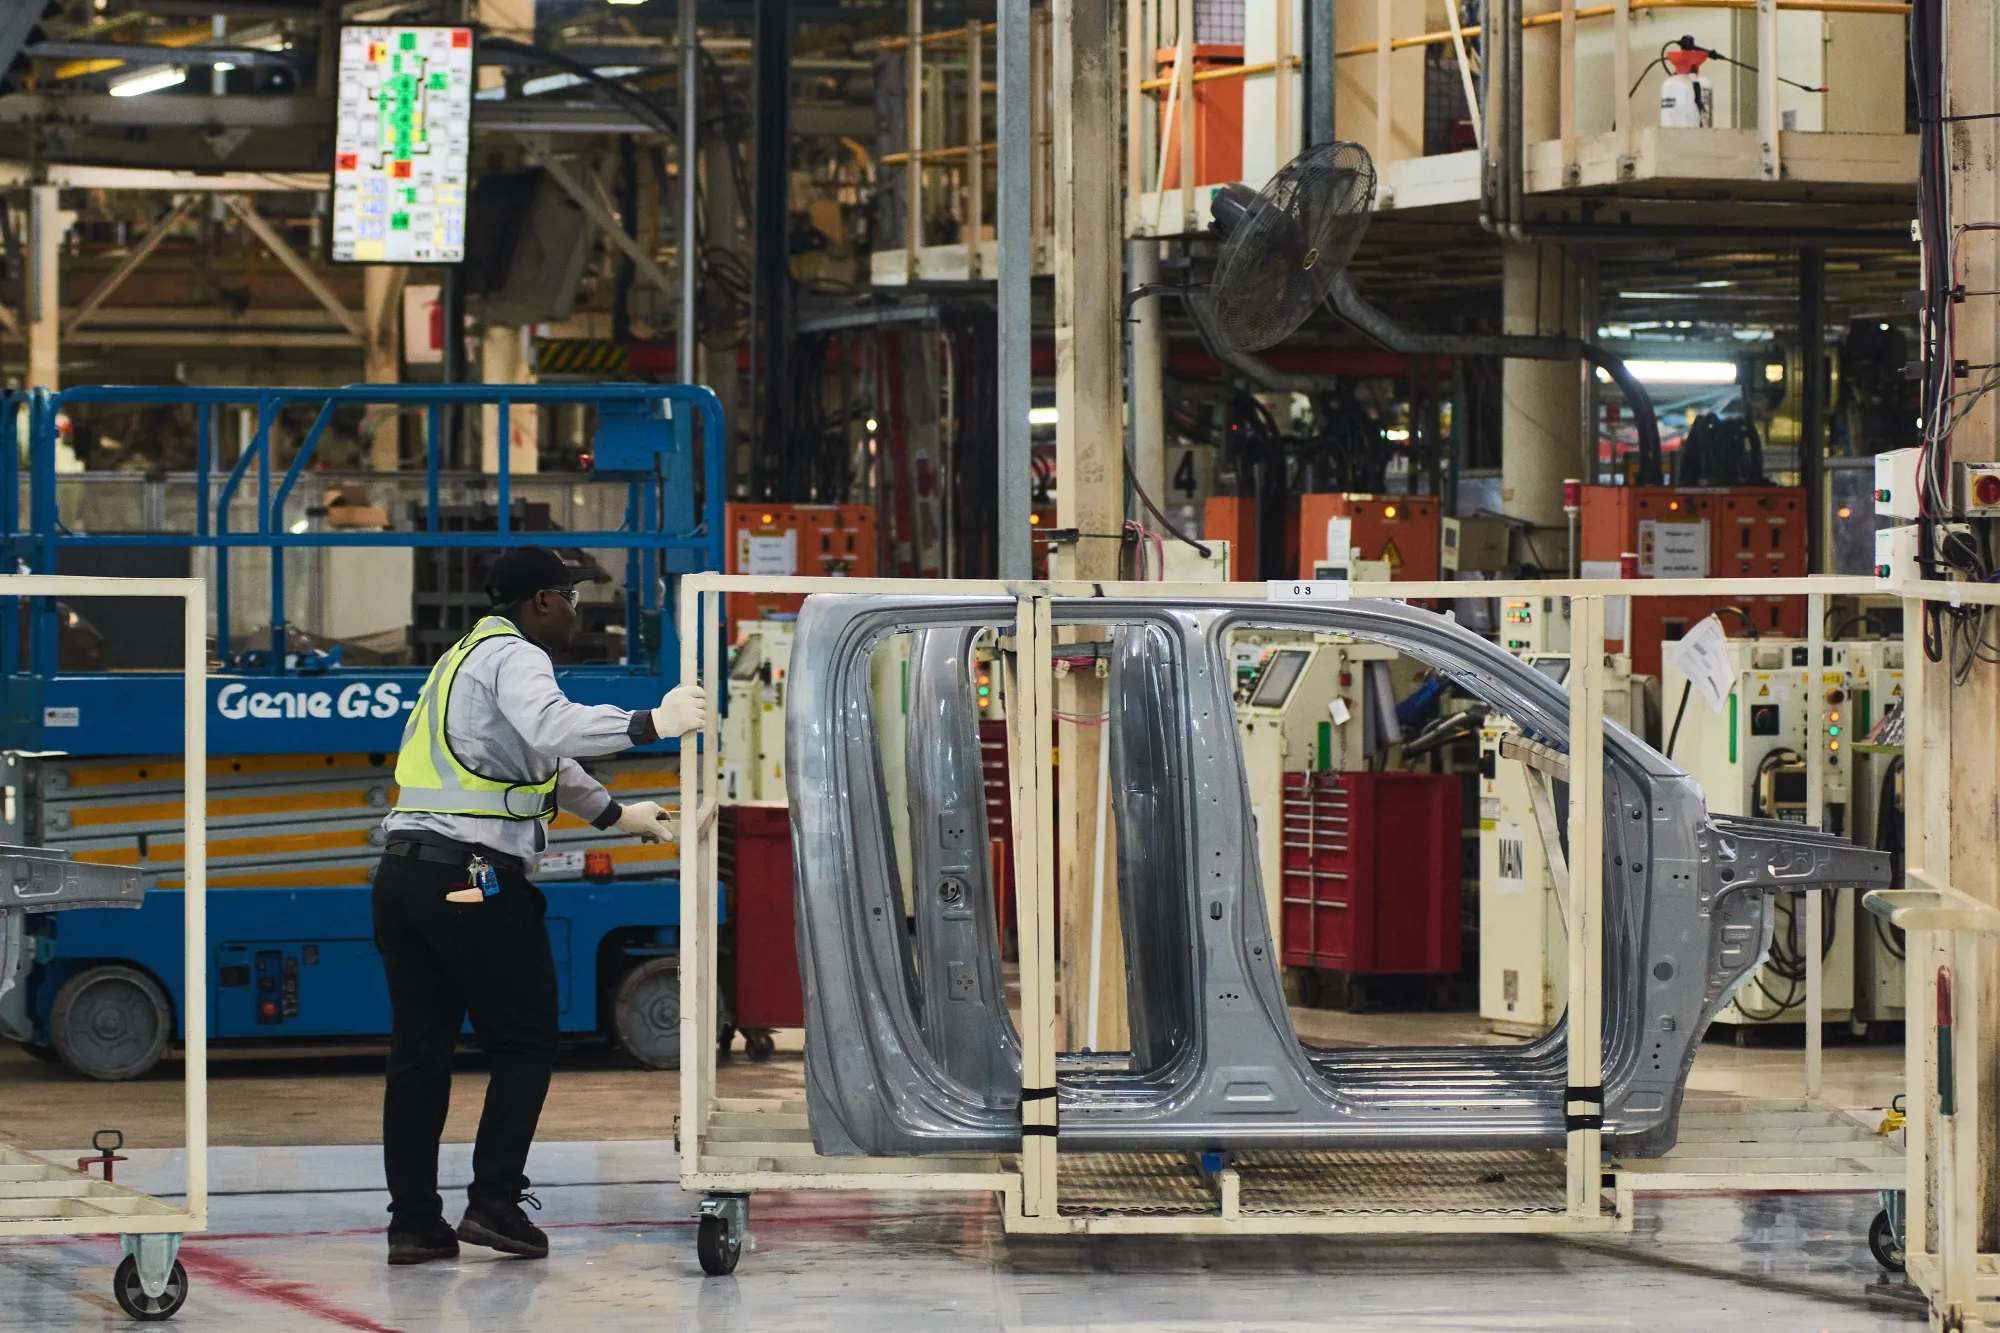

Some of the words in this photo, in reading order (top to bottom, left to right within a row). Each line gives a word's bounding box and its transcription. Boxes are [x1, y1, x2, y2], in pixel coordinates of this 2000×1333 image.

[1173, 450, 1197, 498] 4
[216, 683, 332, 720] Genie
[337, 682, 428, 719] GS-
[1499, 838, 1523, 880] MAIN
